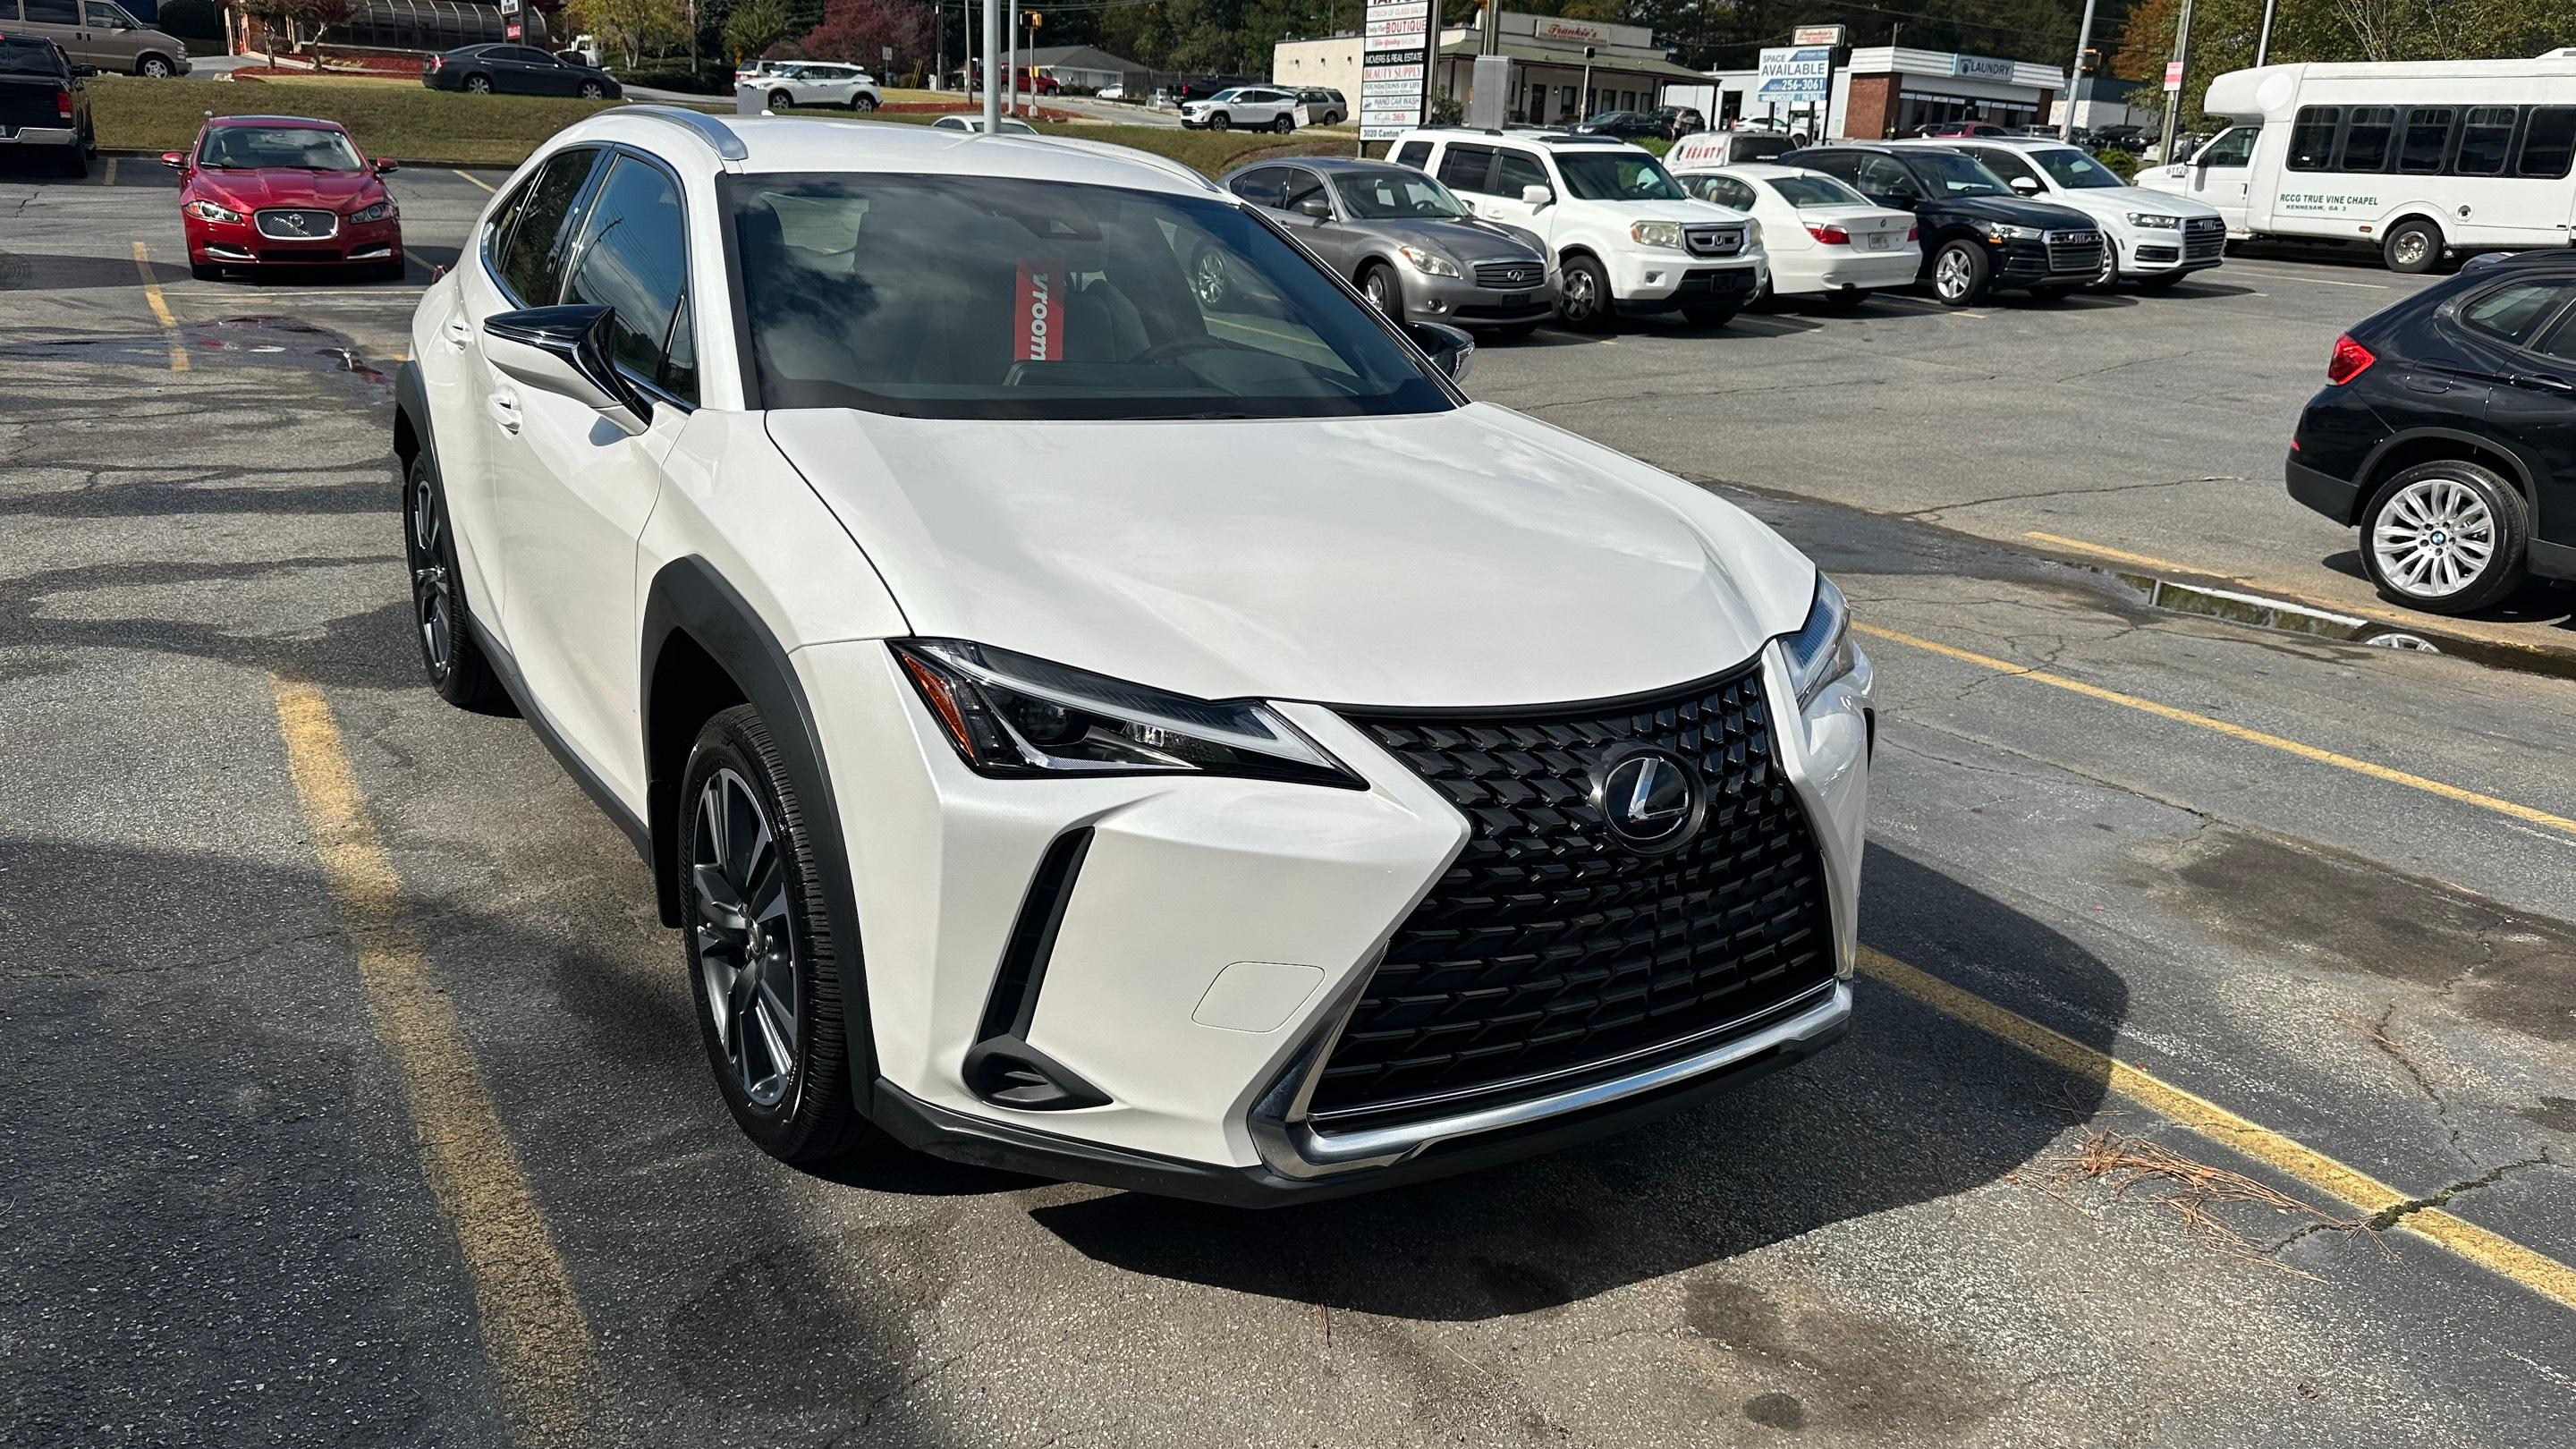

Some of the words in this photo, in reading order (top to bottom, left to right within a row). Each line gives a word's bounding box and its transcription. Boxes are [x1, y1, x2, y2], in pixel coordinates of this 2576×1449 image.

[1385, 20, 1427, 33] BOUTIQUE
[1547, 23, 1597, 38] Frankie's
[1365, 55, 1385, 64] MOVERS
[1391, 54, 1403, 63] REAL
[1404, 52, 1423, 62] ESTATE
[1762, 55, 1786, 63] SPACE
[1365, 68, 1392, 80] BEAUTY
[1394, 66, 1421, 79] SUPPLY
[1761, 63, 1825, 76] AVAILABLE
[1970, 62, 2011, 75] LAUNDRY
[1391, 97, 1402, 106] CAR
[1363, 130, 1377, 138] 3020
[1378, 130, 1399, 138] Canton
[1685, 147, 1724, 159] BEAUTY
[2165, 165, 2189, 175] 61128
[2280, 194, 2301, 202] RCCG
[2303, 194, 2324, 203] TRUE
[2326, 195, 2344, 204] VINE
[2346, 197, 2378, 206] CHAPEL
[1030, 272, 1048, 360] vroom
